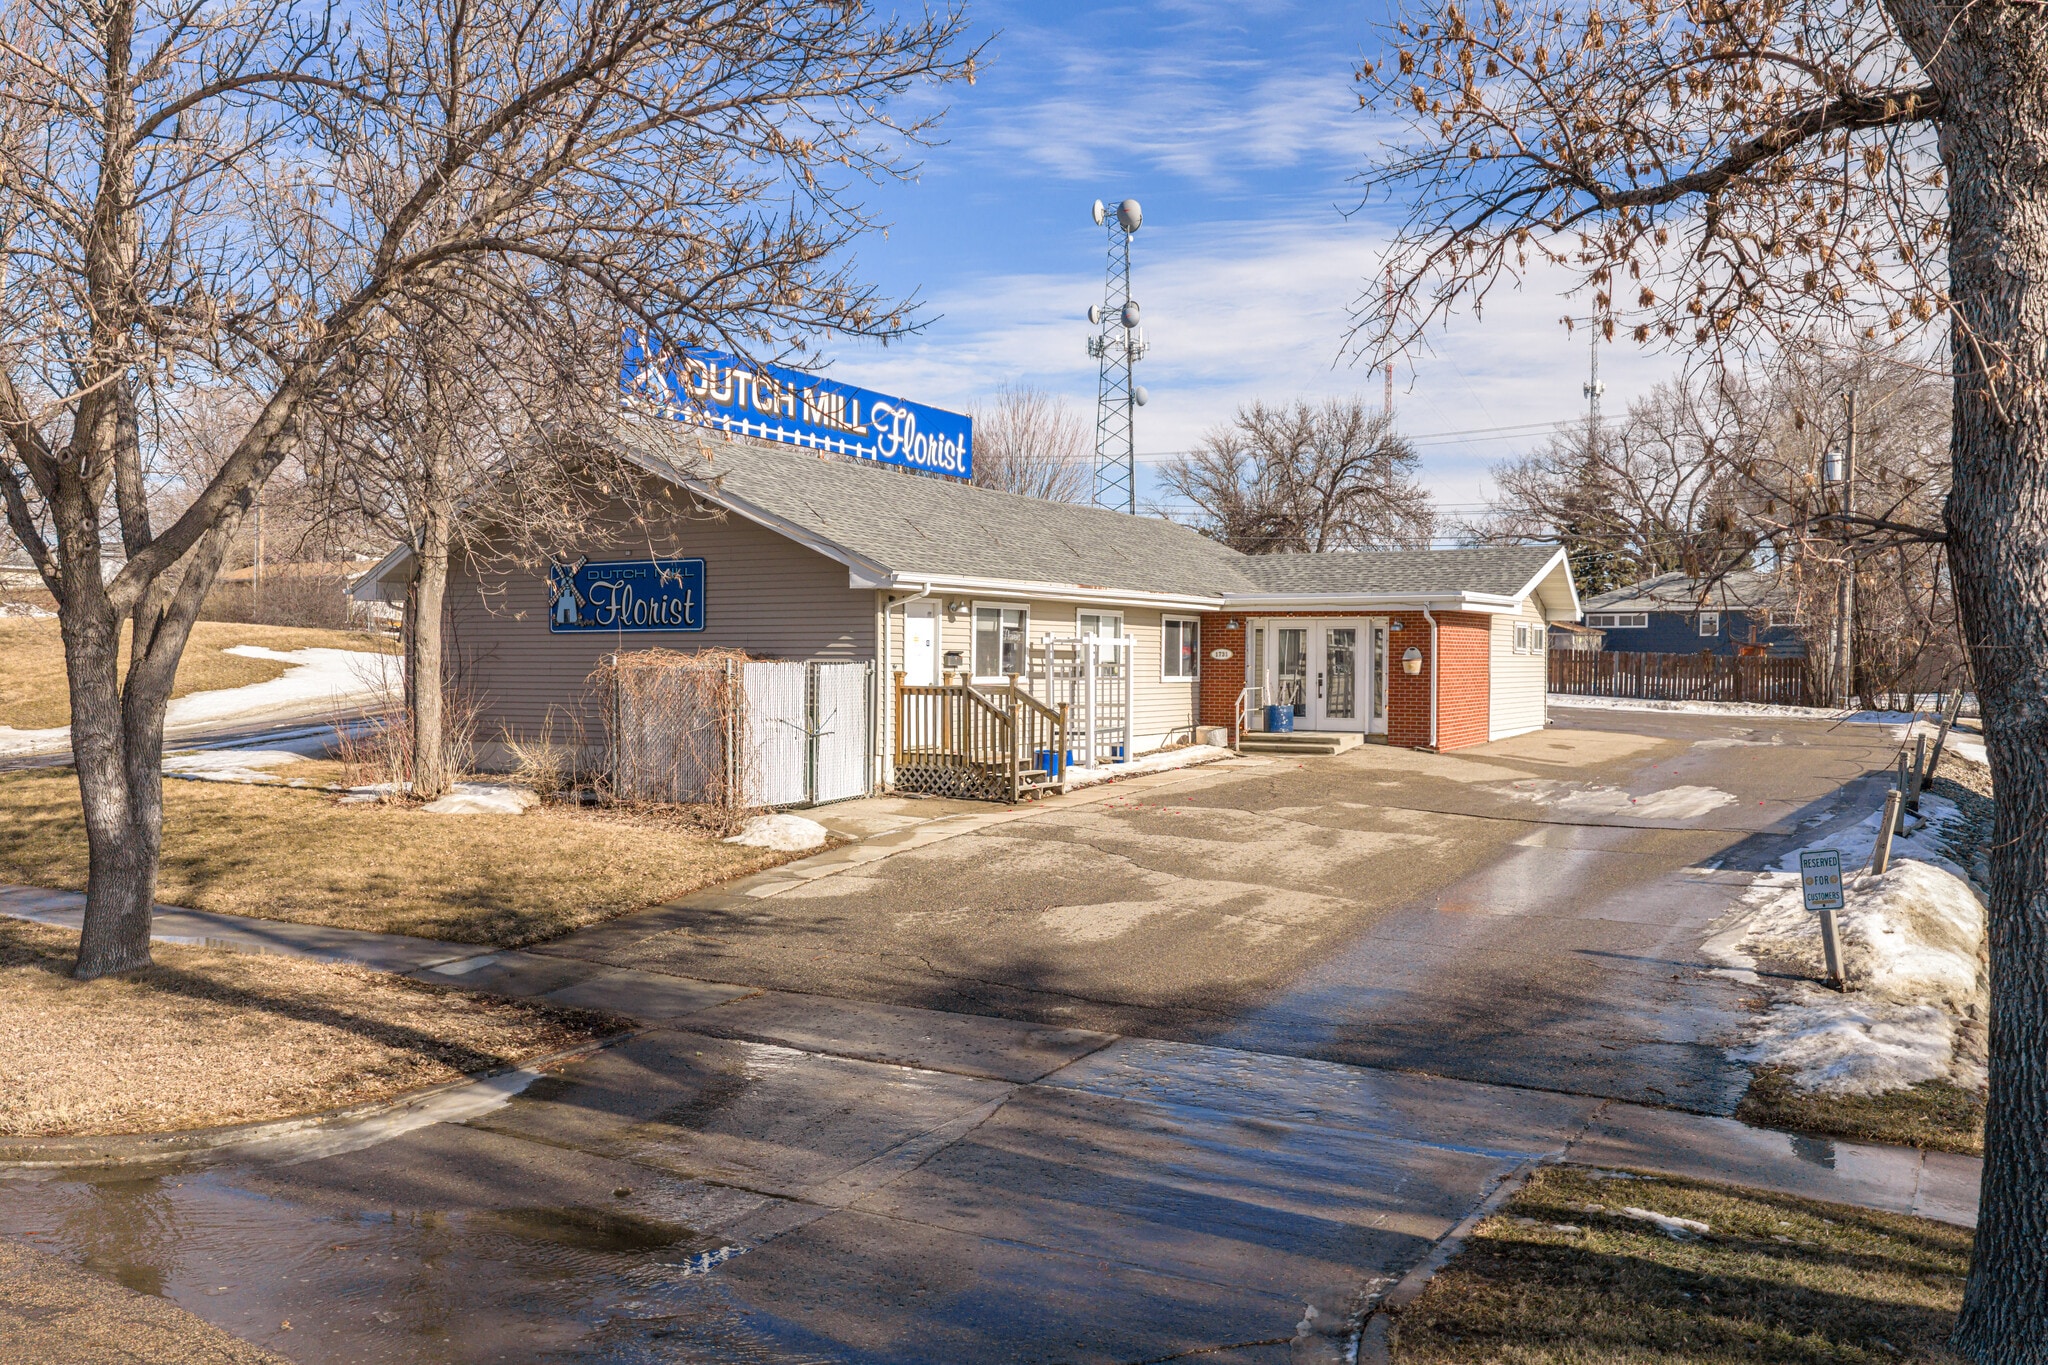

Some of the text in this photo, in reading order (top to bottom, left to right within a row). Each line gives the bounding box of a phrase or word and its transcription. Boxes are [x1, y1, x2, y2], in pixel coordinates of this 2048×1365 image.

[683, 356, 868, 435] DUTCH MILL
[871, 401, 967, 473] Florist
[587, 568, 647, 580] DUTCH
[588, 580, 695, 626] Florist
[1803, 856, 1837, 868] RESERVED
[1814, 875, 1829, 885] FOR
[1807, 892, 1840, 901] CUSTOMERS
